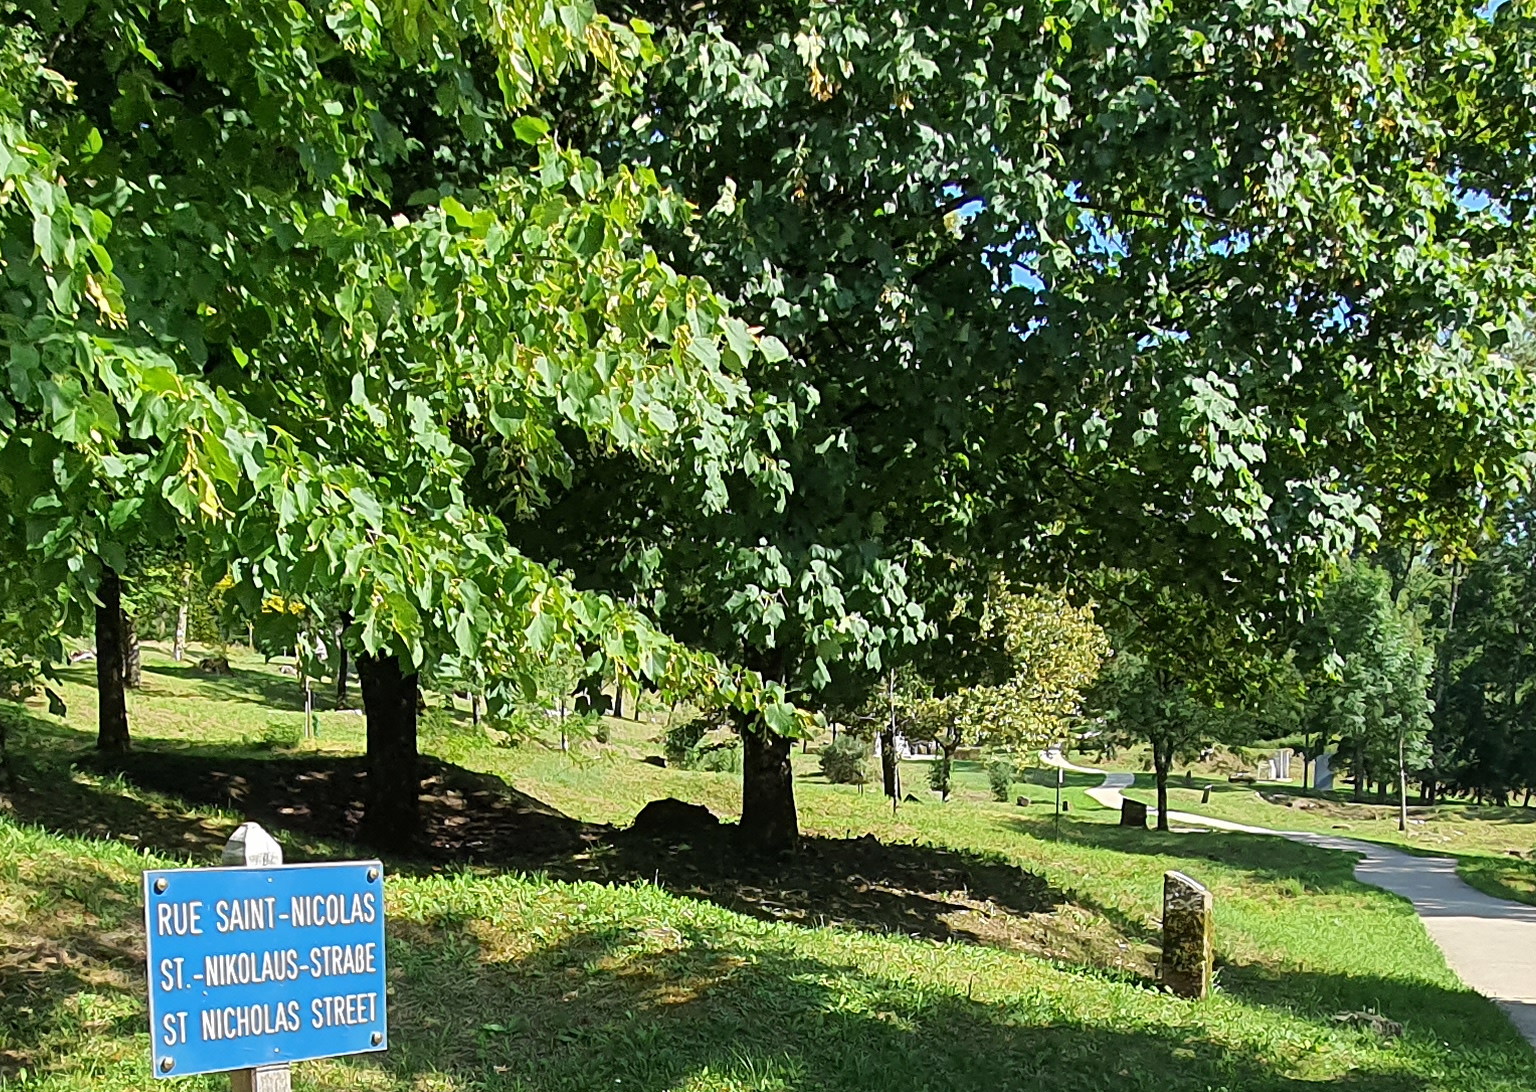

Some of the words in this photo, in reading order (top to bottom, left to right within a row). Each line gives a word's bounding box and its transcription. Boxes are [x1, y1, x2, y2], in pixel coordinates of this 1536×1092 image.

[157, 901, 203, 935] RUE
[215, 892, 376, 932] SAINT-NICOLAS
[162, 1011, 189, 1046] ST
[201, 1000, 300, 1041] NICHOLAS
[311, 992, 378, 1029] STREET
